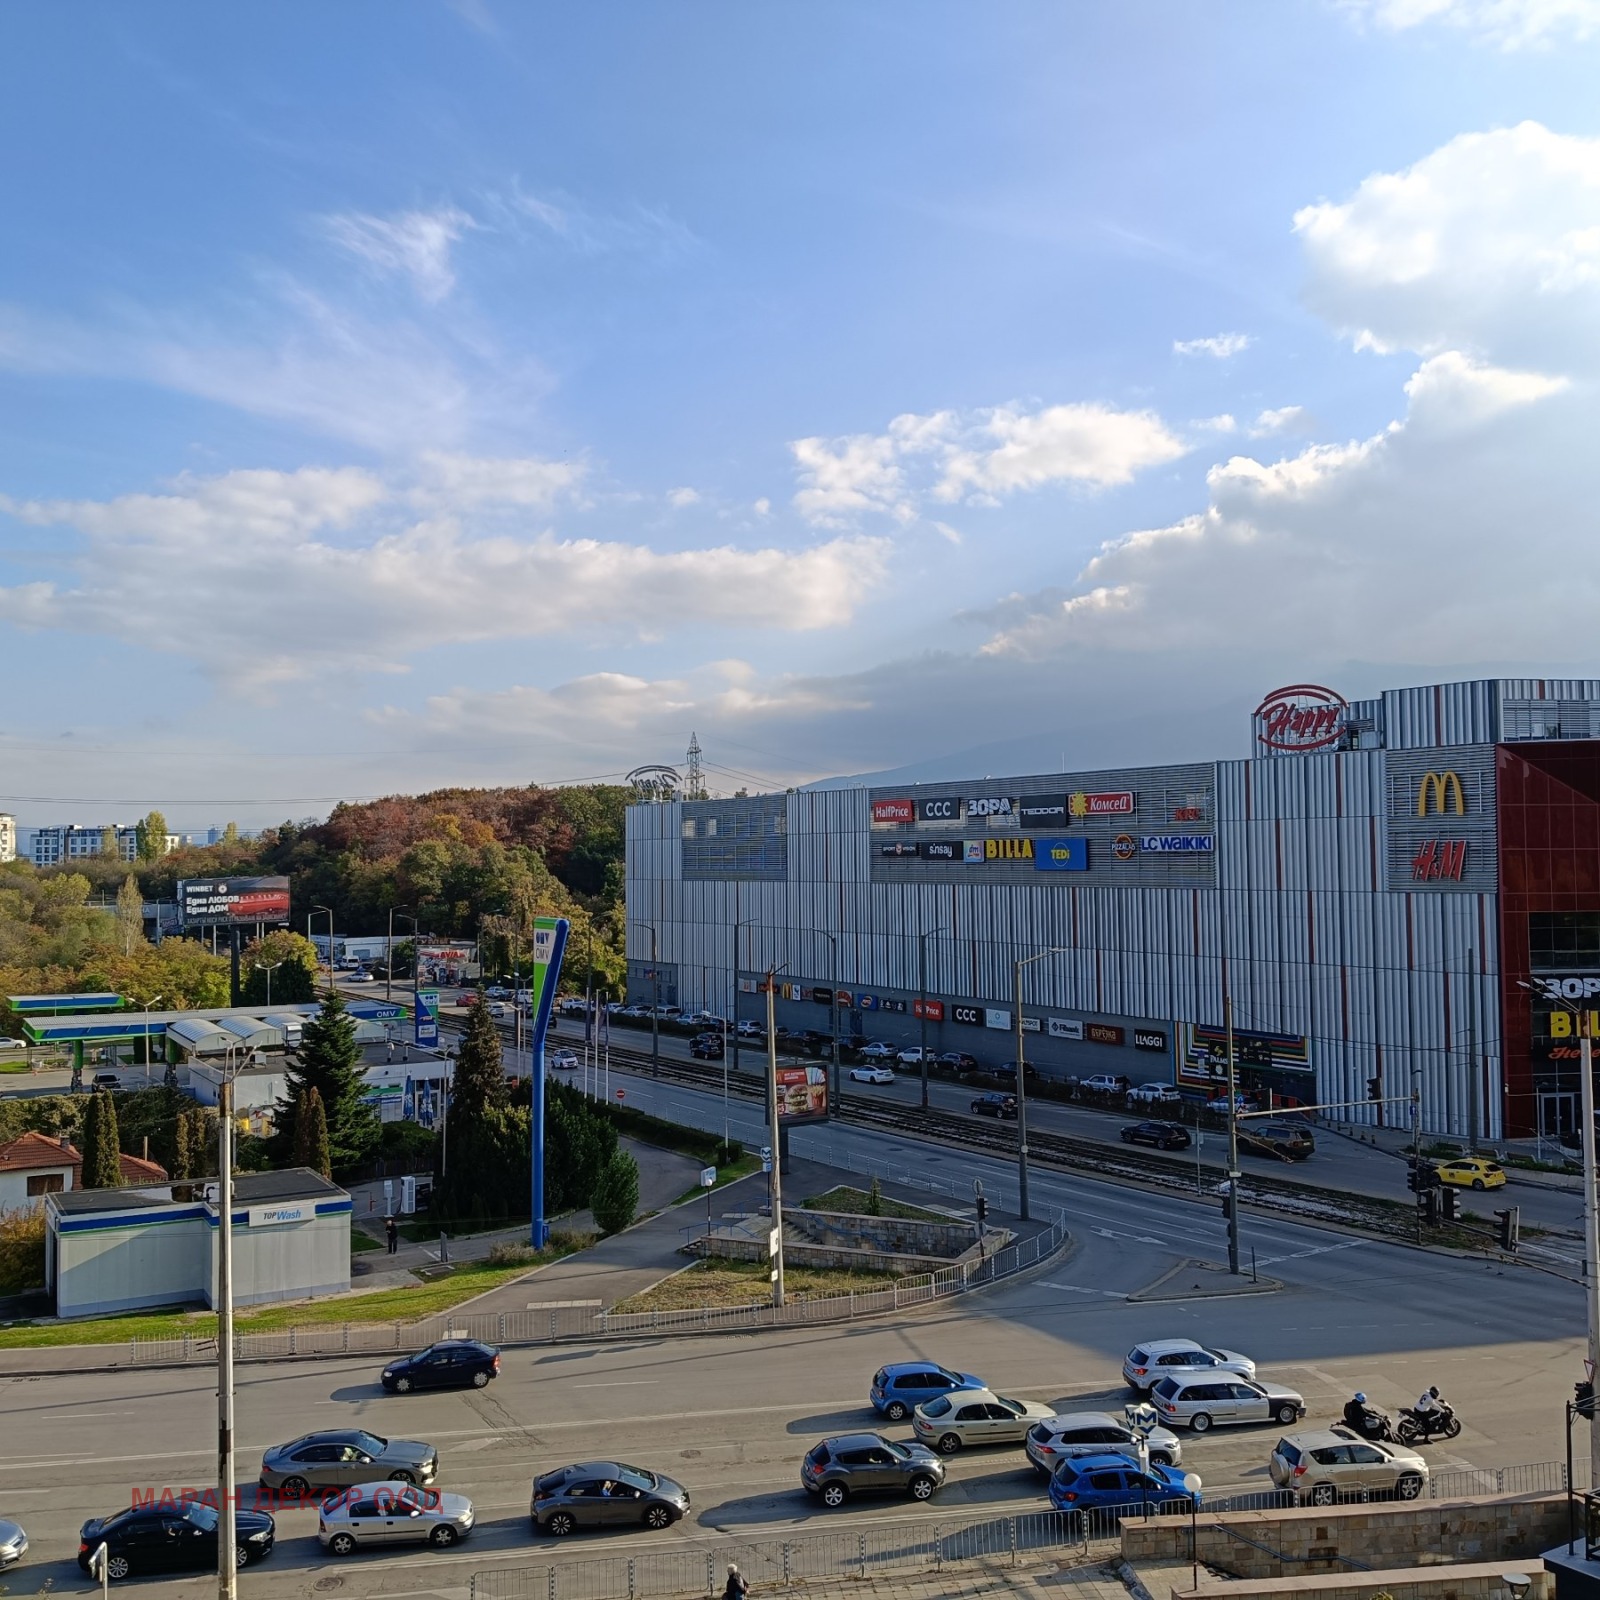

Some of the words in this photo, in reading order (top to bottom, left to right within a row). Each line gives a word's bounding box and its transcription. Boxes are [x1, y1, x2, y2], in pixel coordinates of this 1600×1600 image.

[1262, 702, 1340, 738] Happy
[875, 806, 909, 818] HalfPrice
[926, 802, 951, 816] CCC
[968, 798, 1012, 815] ЗОРА
[1021, 807, 1064, 815] TEODOR
[929, 843, 953, 857] sinsay
[986, 838, 1033, 858] BILLA
[1141, 837, 1158, 851] LC
[1051, 849, 1070, 859] TEDi
[1412, 840, 1467, 881] H&M
[186, 885, 213, 893] WINBET
[208, 895, 240, 904] ЛЮБОВ
[208, 905, 229, 914] ДОМ
[535, 948, 549, 960] OMV
[956, 1008, 977, 1021] CCC
